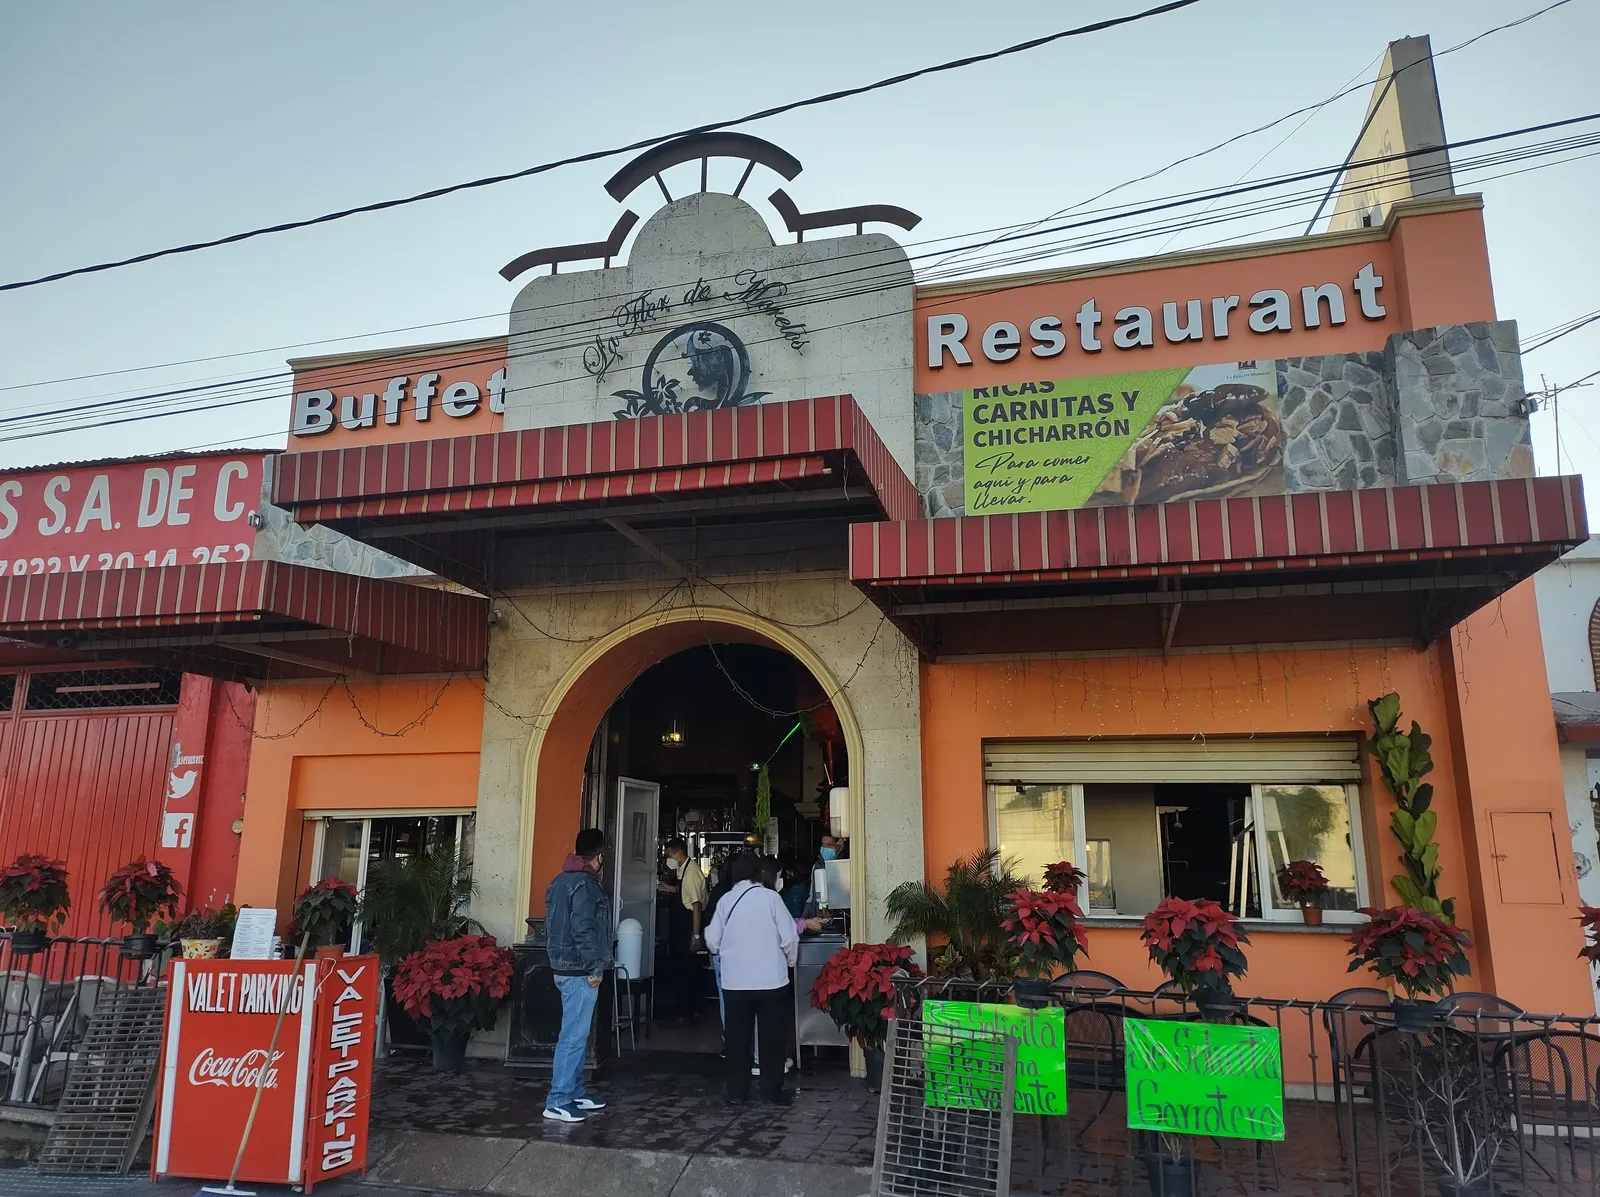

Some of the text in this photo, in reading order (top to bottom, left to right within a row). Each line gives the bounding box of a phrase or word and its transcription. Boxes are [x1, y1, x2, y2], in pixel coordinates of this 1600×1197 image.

[926, 261, 1387, 370] Restaurant
[292, 366, 506, 438] Buffet
[972, 380, 1055, 400] RICAS
[972, 390, 1140, 425] CARNITAS Y
[972, 416, 1130, 448] CHICHARRÓN
[974, 451, 1094, 475] Para comer
[1011, 478, 1031, 494] y
[1029, 473, 1074, 492] para
[38, 475, 121, 536] S.A.
[137, 464, 197, 528] DE
[187, 972, 304, 1015] VALET PARKING
[188, 1047, 286, 1088] Coca-Cola
[321, 965, 366, 1172] VALET PARKING
